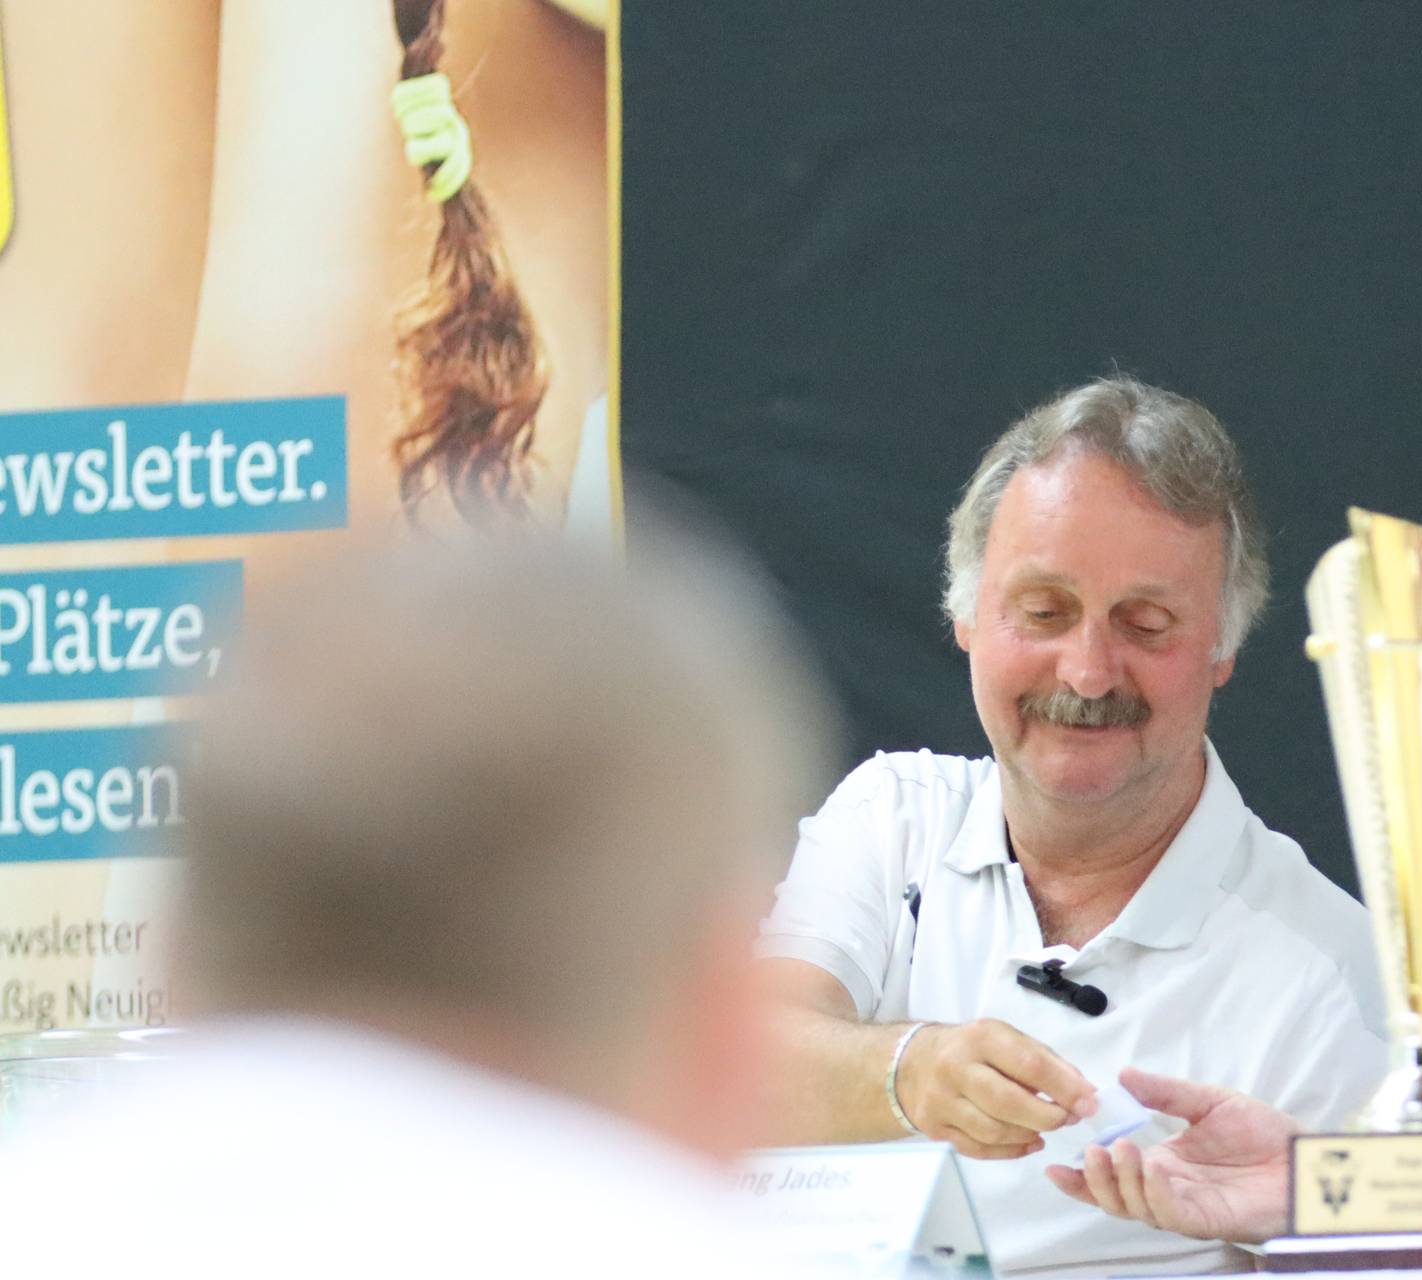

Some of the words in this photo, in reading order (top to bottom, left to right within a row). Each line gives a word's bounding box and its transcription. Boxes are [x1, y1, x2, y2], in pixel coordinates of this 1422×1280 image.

[0, 420, 328, 517] wsletter.
[0, 912, 148, 957] wsletter
[776, 1163, 852, 1191] Jades
